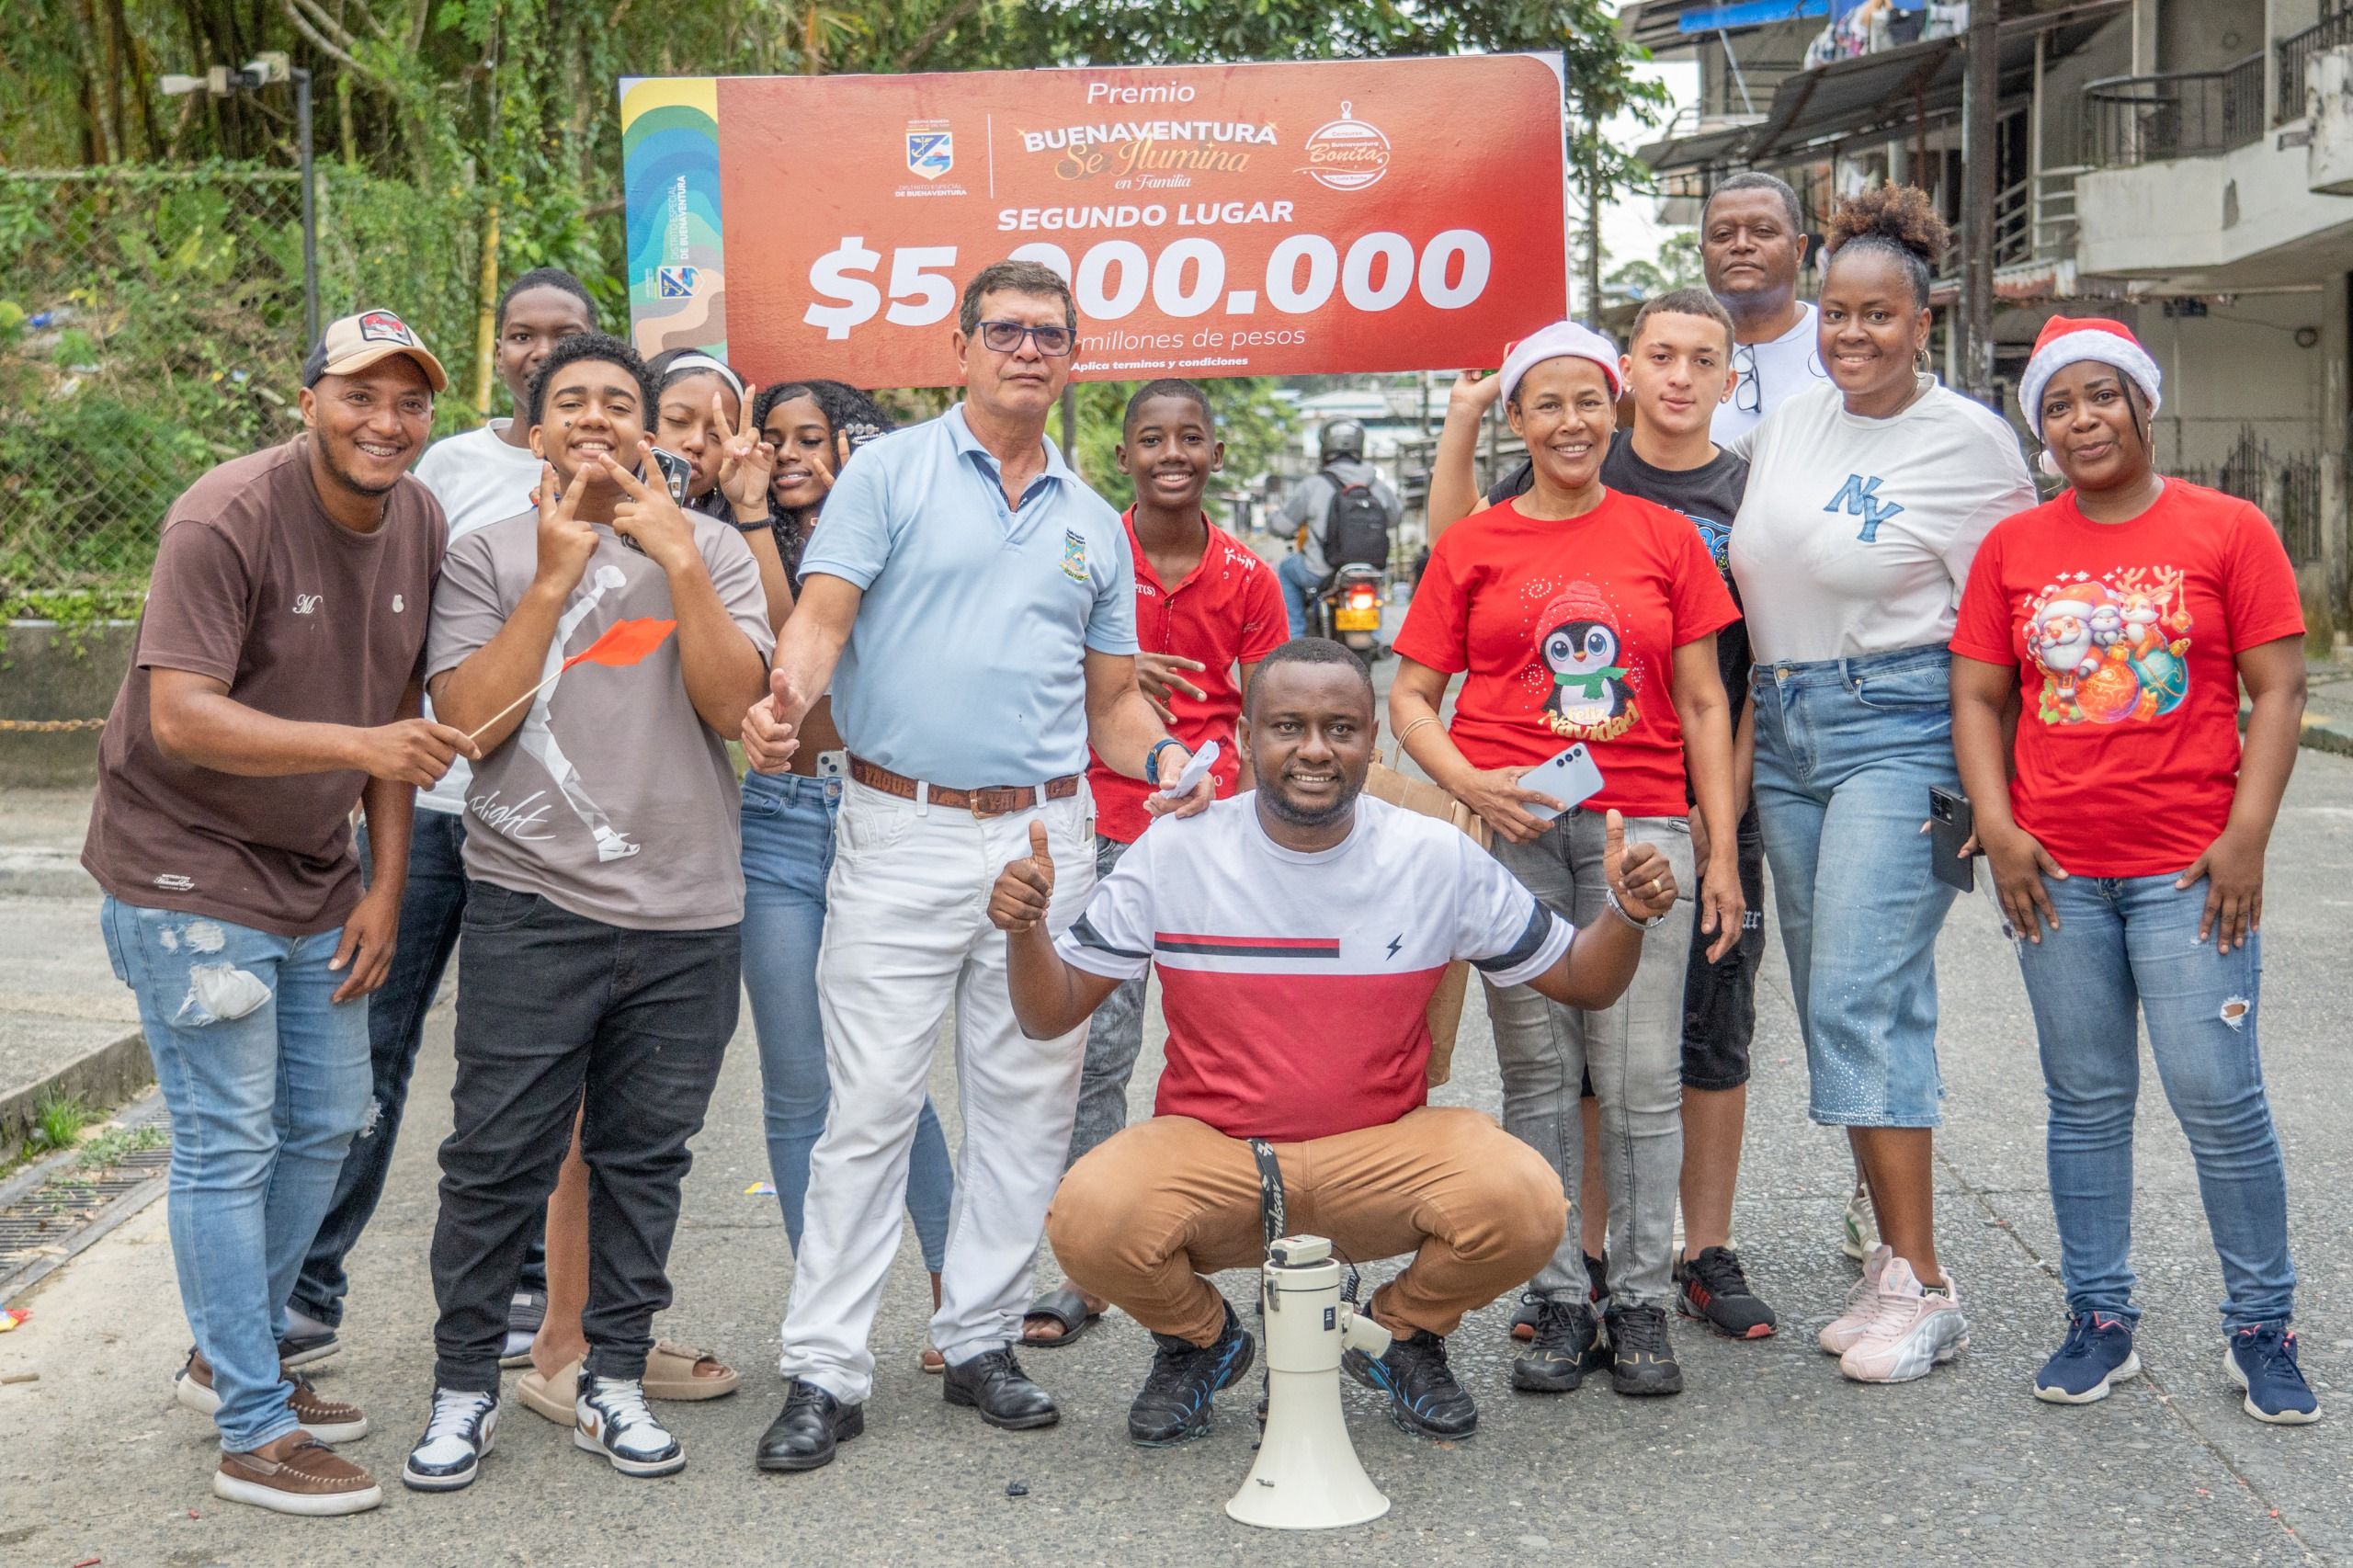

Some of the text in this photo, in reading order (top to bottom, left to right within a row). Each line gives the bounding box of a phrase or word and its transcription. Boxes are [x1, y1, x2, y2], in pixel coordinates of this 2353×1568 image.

[1087, 81, 1196, 105] Premio
[1024, 120, 1279, 153] BUENAVENTURA
[1054, 134, 1252, 181] Se Ilumina
[1309, 142, 1381, 163] Bonita
[907, 189, 967, 198] BUENAVENTURA
[1115, 173, 1192, 191] en Familia
[677, 175, 689, 260] DE BUENAVENTURA
[997, 200, 1294, 232] SEGUNDO LUGAR
[1081, 328, 1306, 351] millones de pesos
[1071, 356, 1249, 372] Aplica terminos y condiciones
[1823, 473, 1905, 543] NY
[292, 594, 324, 614] M
[1538, 699, 1640, 742] Navidad
